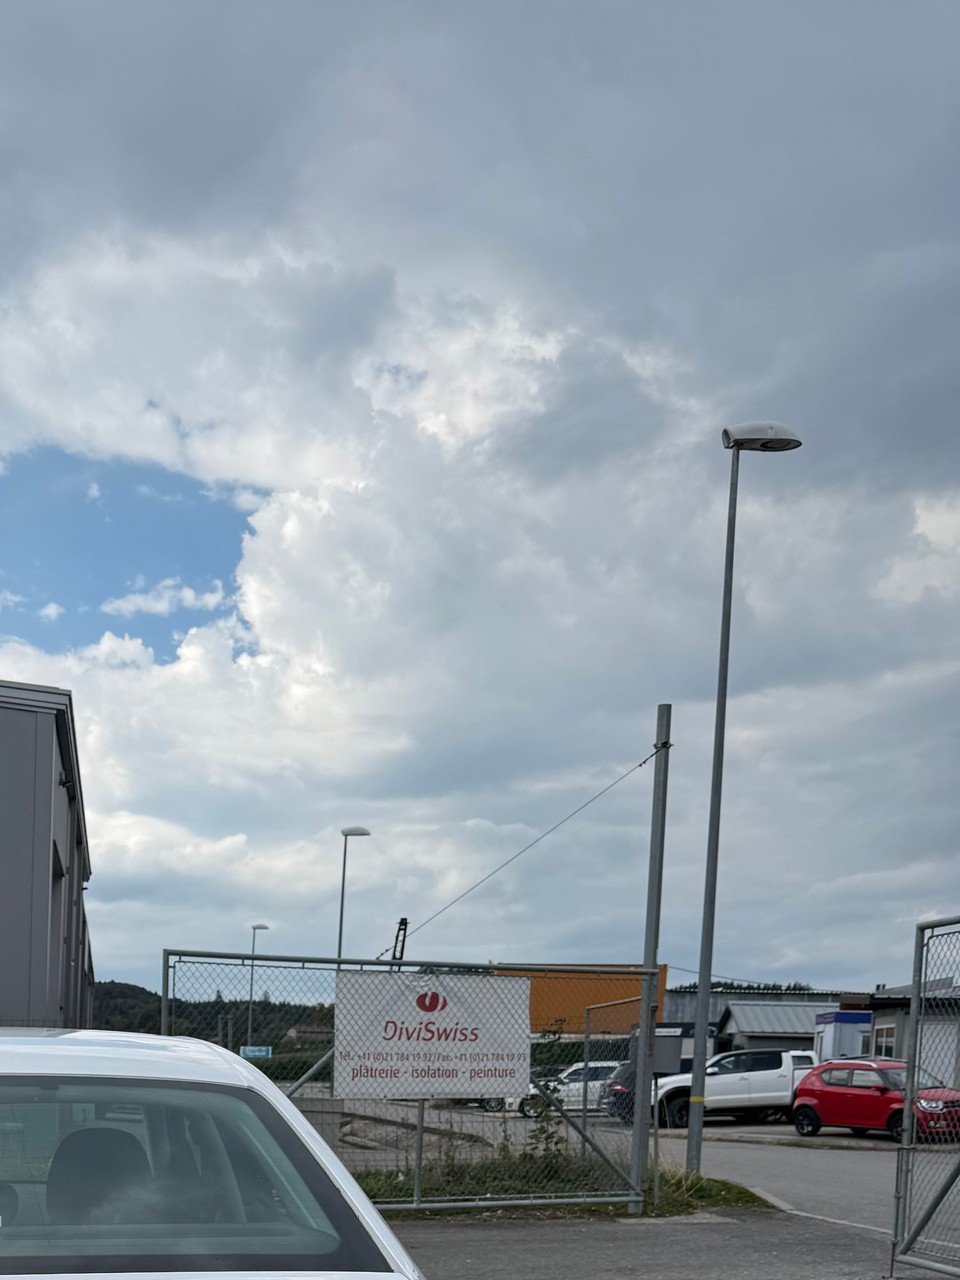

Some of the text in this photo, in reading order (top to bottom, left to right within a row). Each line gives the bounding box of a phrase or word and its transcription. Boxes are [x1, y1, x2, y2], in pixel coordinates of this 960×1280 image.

[382, 1020, 480, 1042] DiviSwiss
[358, 1052, 371, 1061] +41
[373, 1052, 393, 1063] (0)21
[395, 1052, 409, 1061] 784
[412, 1052, 421, 1061] 19
[469, 1053, 489, 1062] (0)21
[490, 1053, 504, 1062] 784
[352, 1065, 400, 1081] plâtrerie
[411, 1066, 458, 1079] isolation
[469, 1066, 516, 1081] peinture
